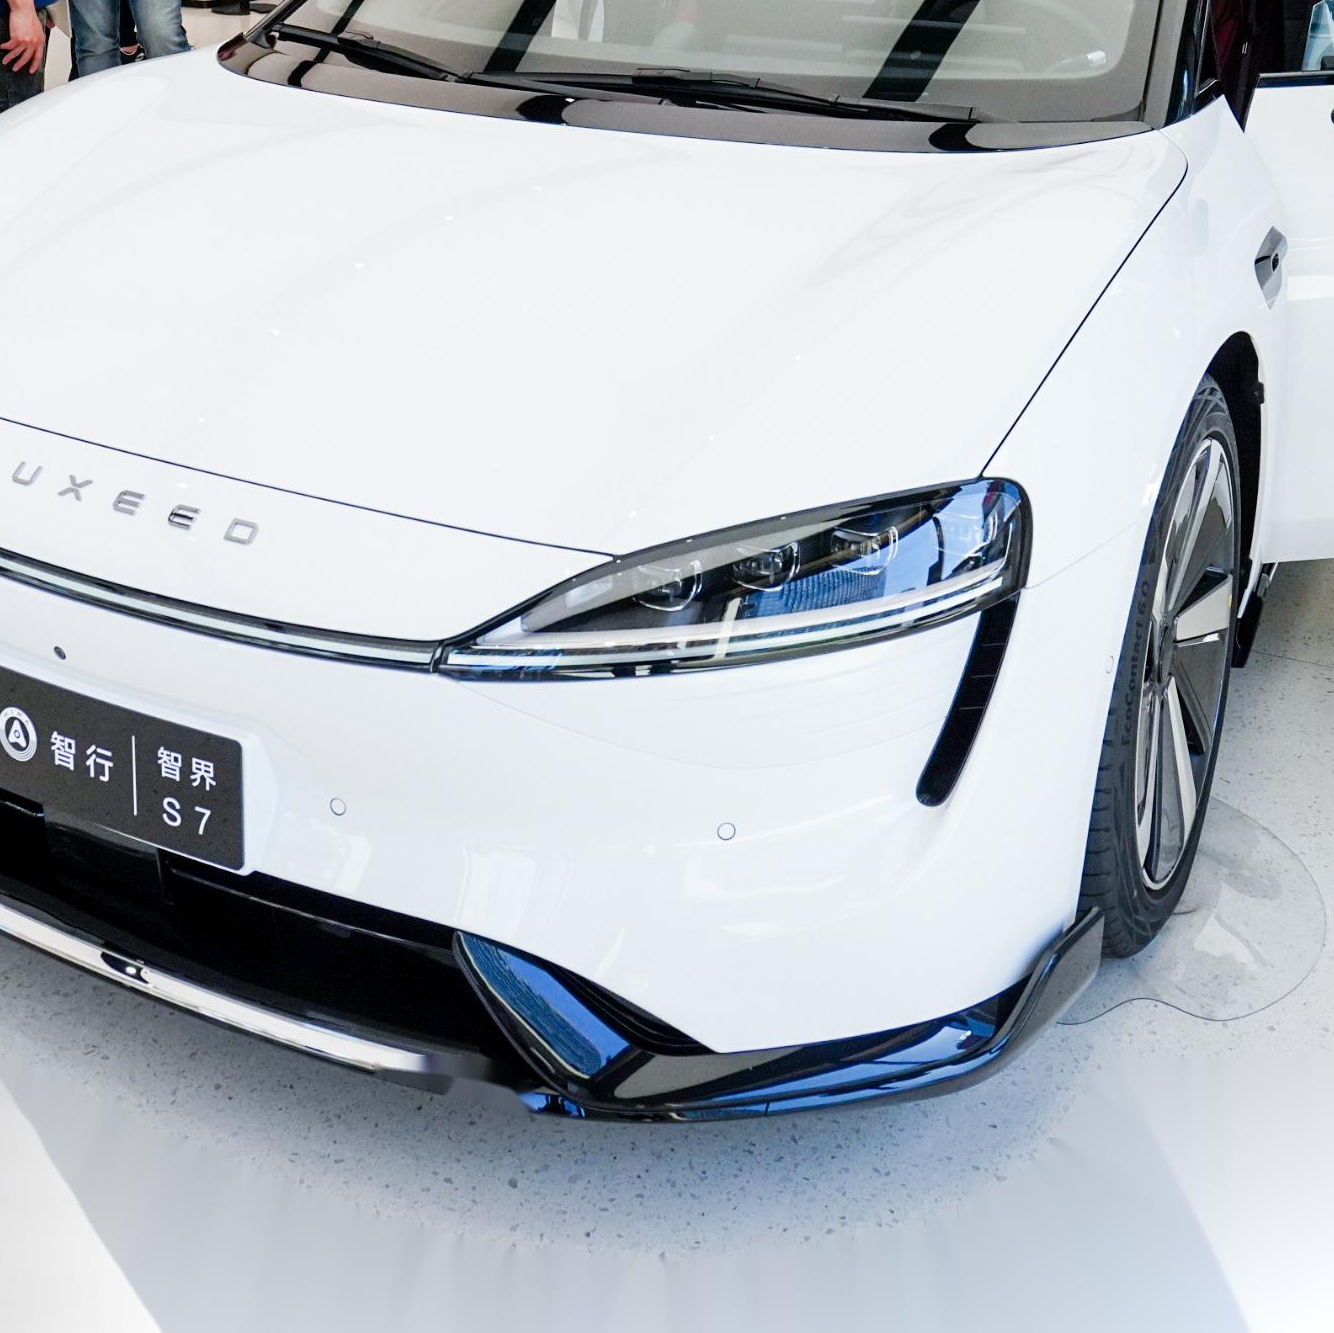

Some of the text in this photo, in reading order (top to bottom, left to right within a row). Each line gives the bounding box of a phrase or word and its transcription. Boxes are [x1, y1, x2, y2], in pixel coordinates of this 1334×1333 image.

[1122, 621, 1143, 746] EcoContact
[50, 730, 114, 782] 智行
[157, 745, 217, 792] 智界
